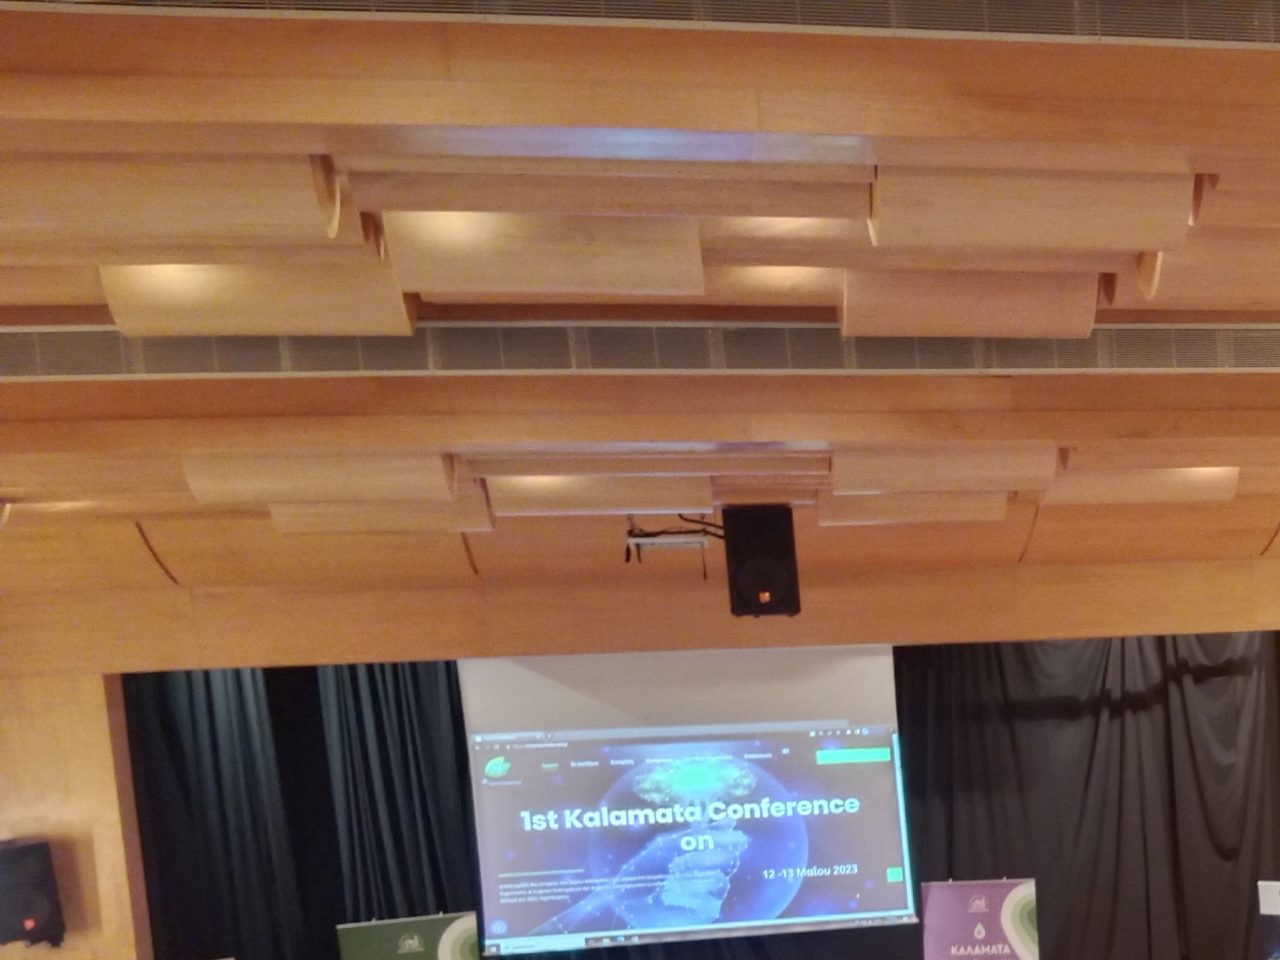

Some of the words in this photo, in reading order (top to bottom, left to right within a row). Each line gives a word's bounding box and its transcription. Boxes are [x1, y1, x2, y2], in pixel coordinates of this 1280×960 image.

[520, 810, 559, 831] 1st
[564, 803, 702, 829] Kalamata
[708, 797, 861, 820] Conference
[680, 833, 715, 852] on
[762, 869, 776, 880] 12
[832, 864, 858, 875] 2023
